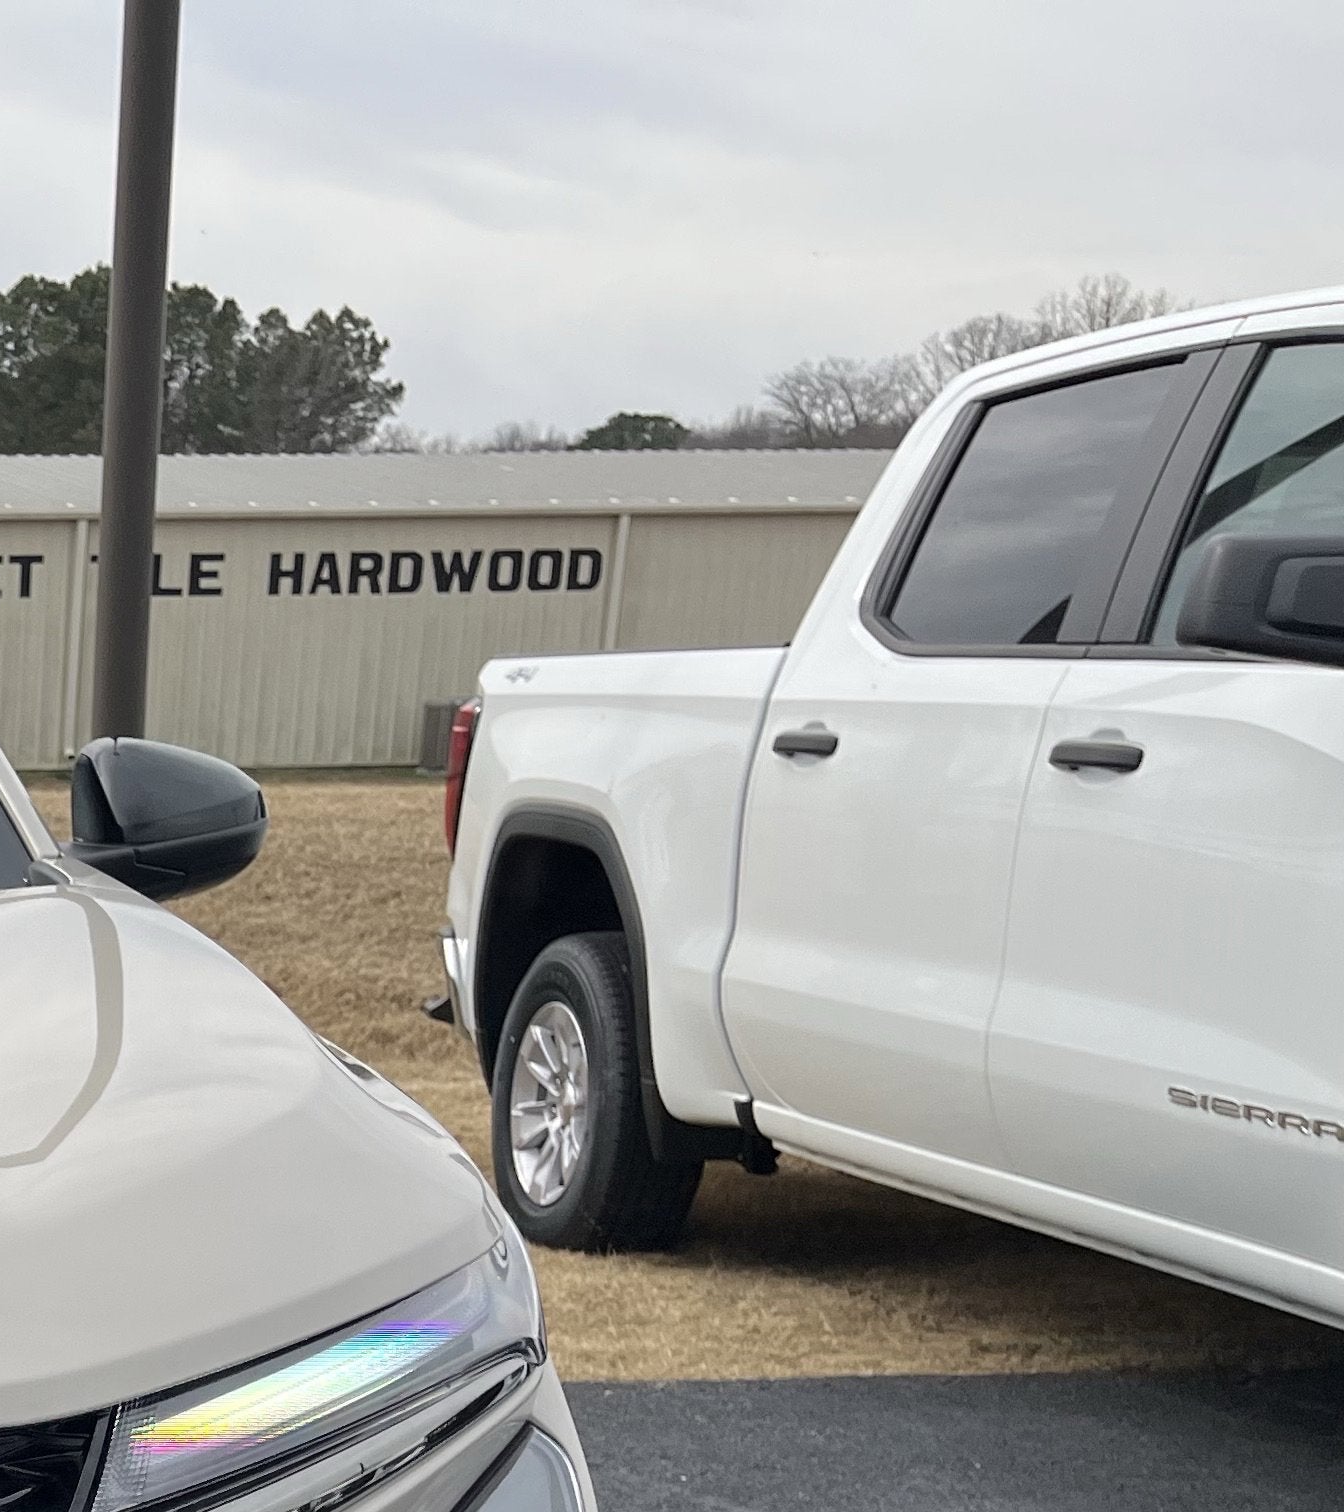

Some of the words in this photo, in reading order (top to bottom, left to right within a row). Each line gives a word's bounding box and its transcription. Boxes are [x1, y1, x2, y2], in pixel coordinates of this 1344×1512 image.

[91, 553, 225, 596] LE
[267, 548, 604, 596] HARDWOOD
[1167, 1086, 1344, 1143] SIERRA
